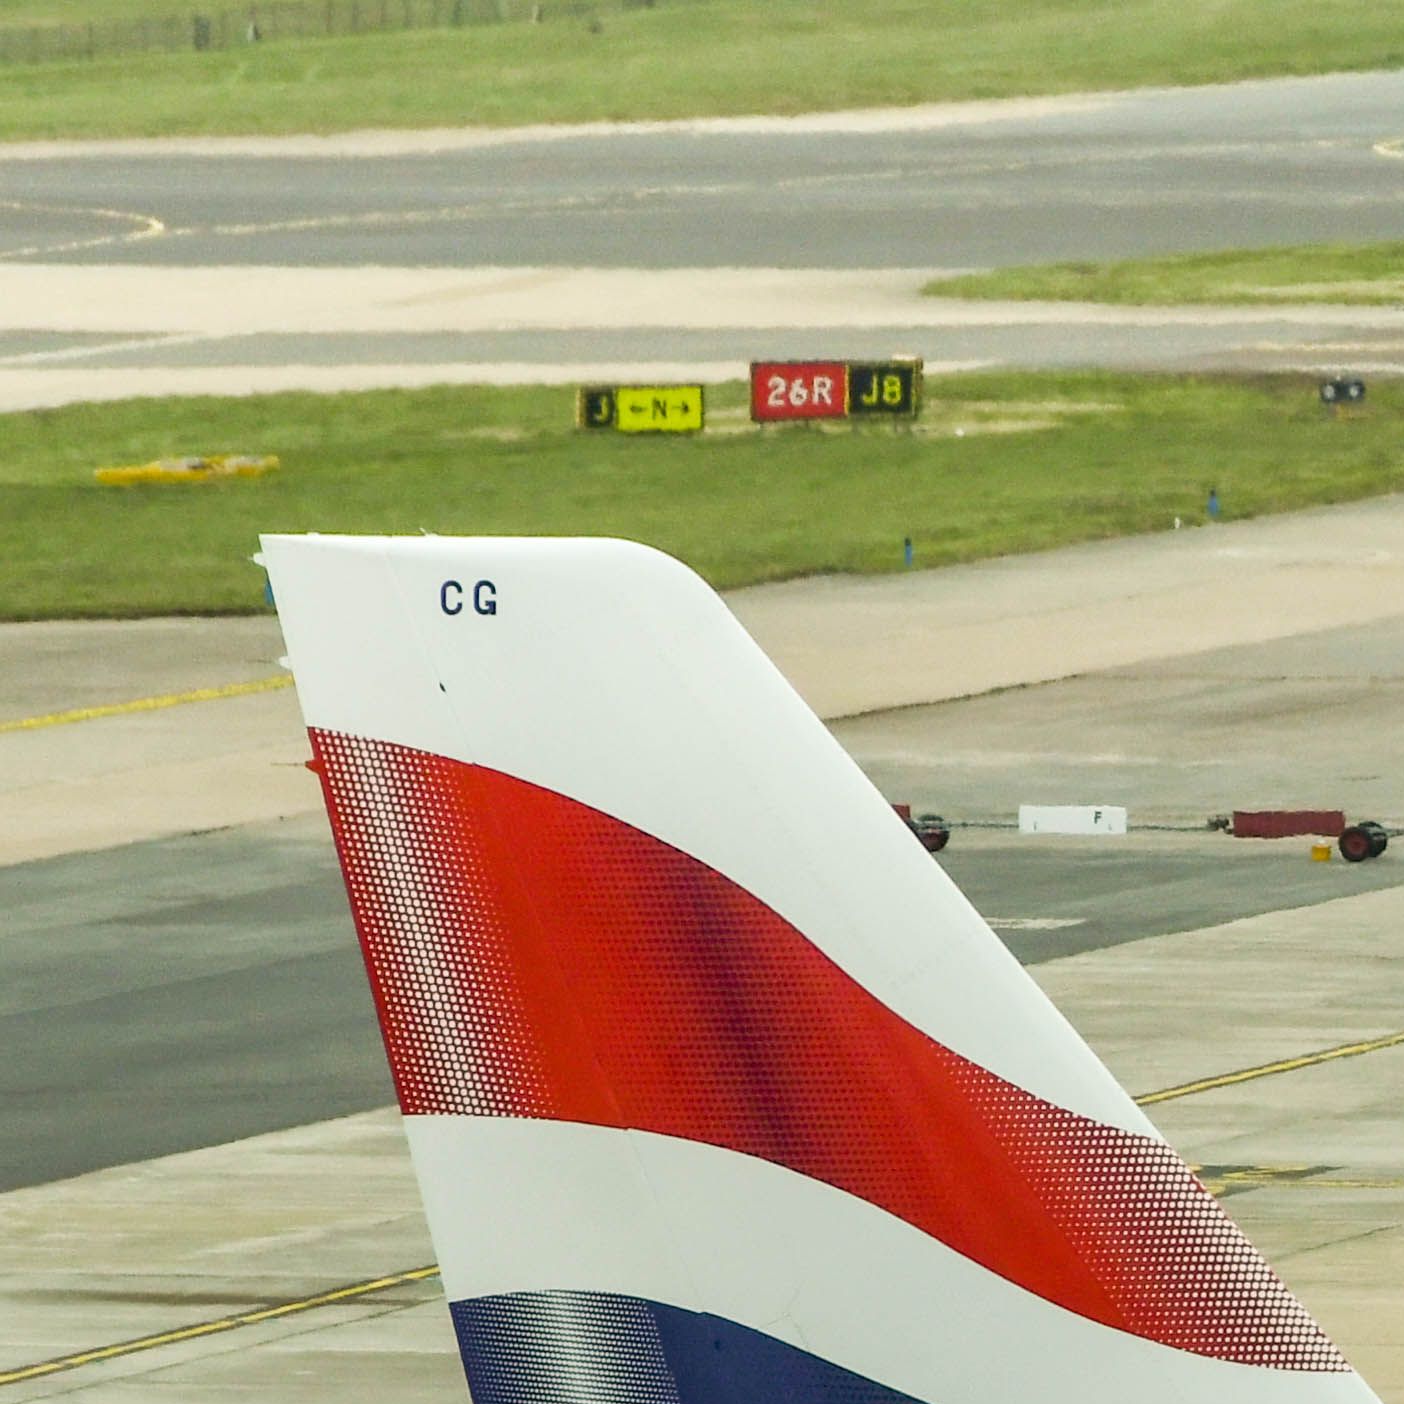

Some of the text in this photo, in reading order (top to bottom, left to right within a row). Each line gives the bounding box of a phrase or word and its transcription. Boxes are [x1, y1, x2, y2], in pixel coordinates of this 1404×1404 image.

[767, 373, 902, 408] 26R J8
[651, 398, 668, 421] N
[440, 580, 497, 616] CG
